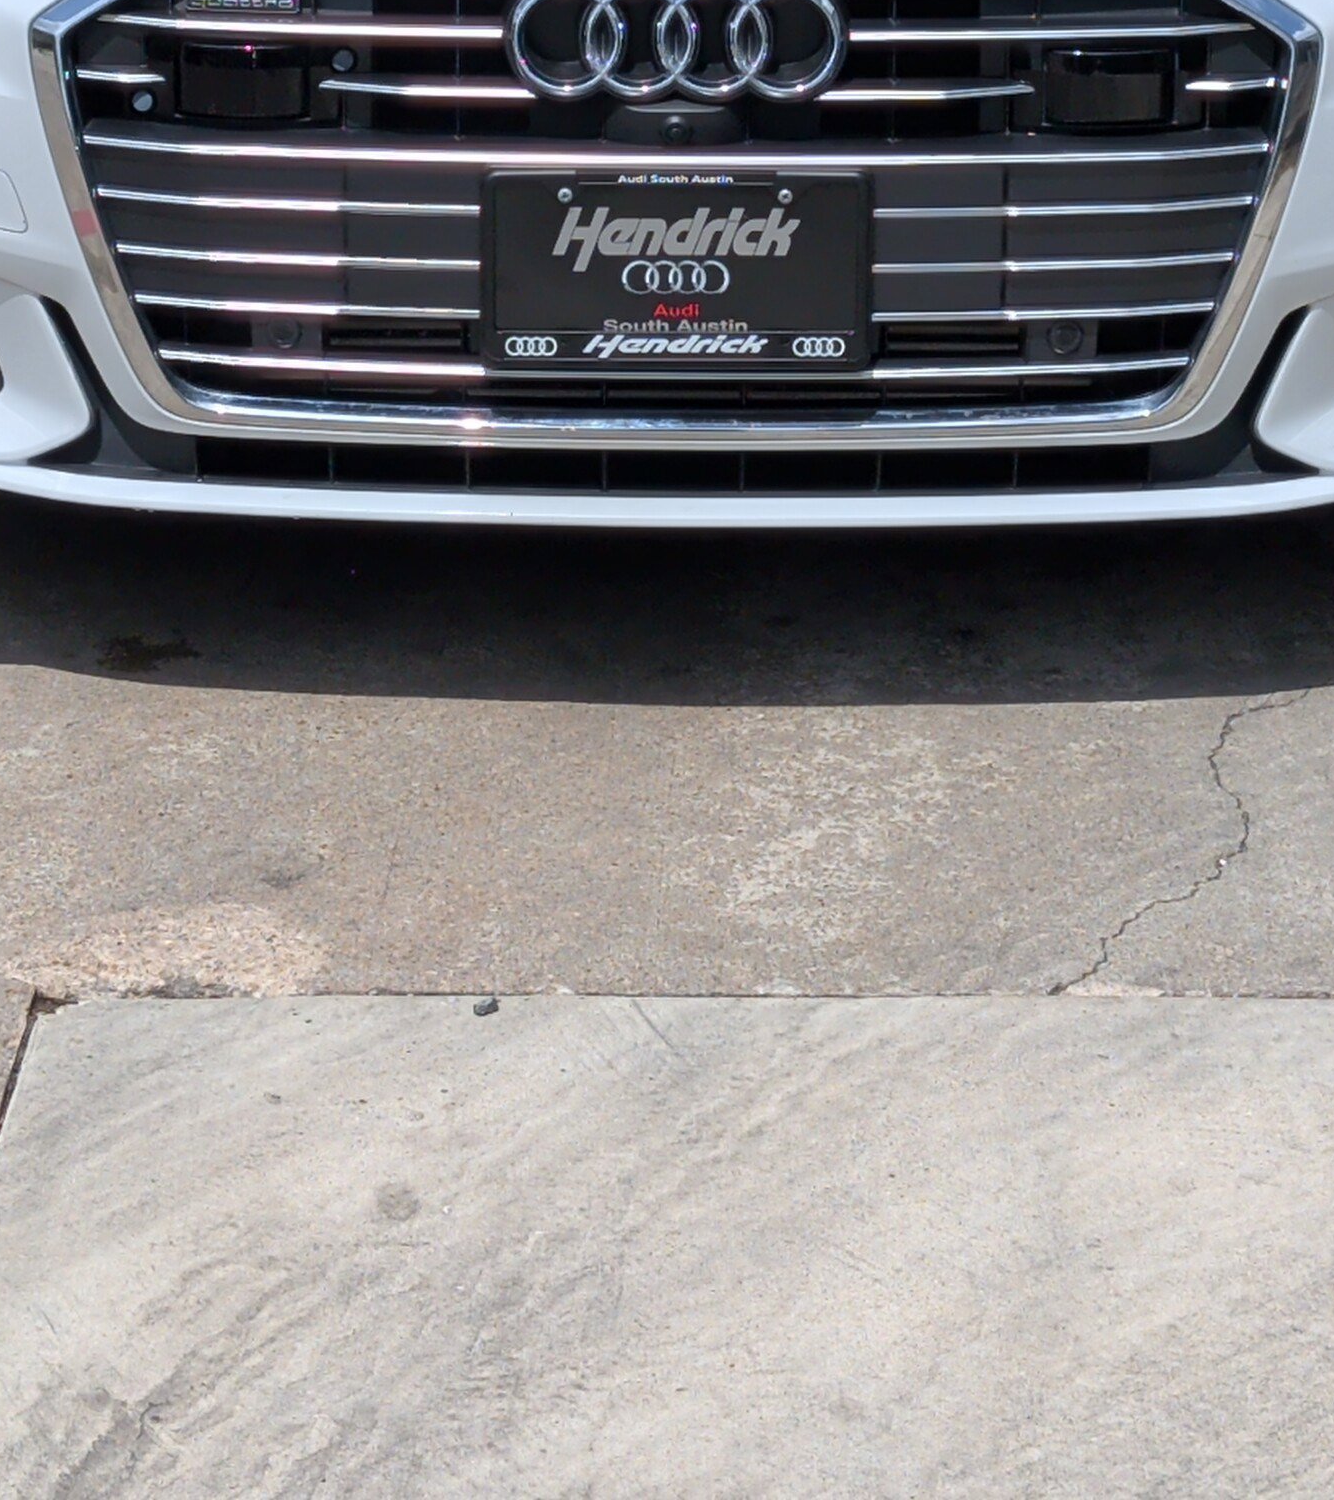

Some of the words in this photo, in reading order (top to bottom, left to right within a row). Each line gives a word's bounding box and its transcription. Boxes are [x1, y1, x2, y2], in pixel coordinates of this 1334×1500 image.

[617, 174, 647, 184] Audi
[649, 174, 688, 184] South
[690, 174, 734, 184] Austin
[552, 206, 801, 272] Hendrick
[653, 303, 700, 318] Audi
[603, 319, 670, 332] South
[677, 319, 749, 332] Austin
[582, 334, 769, 359] Hendrick
